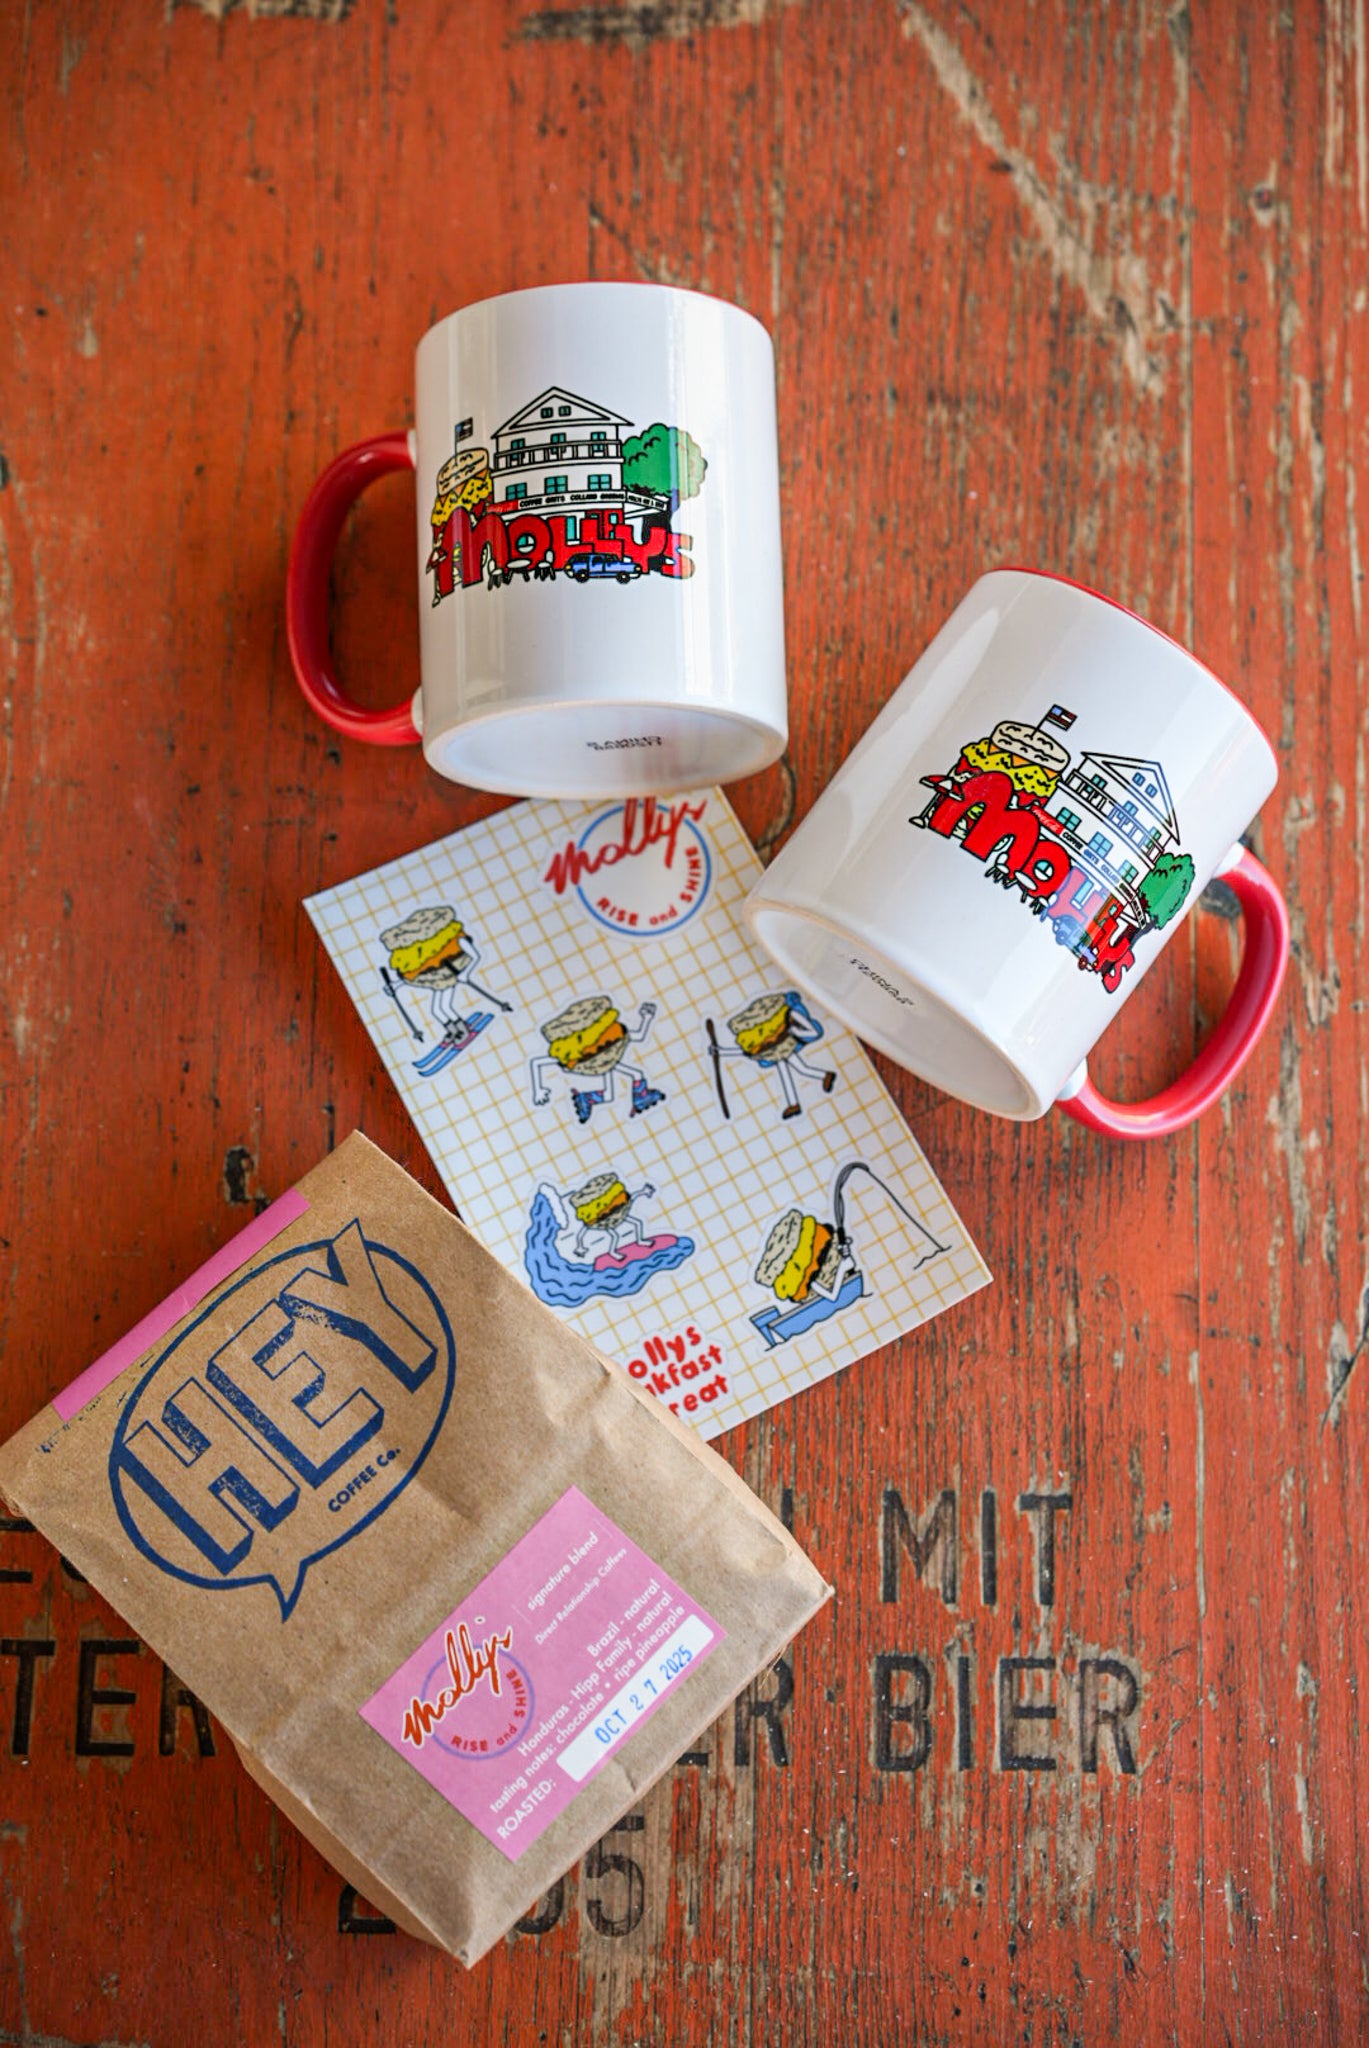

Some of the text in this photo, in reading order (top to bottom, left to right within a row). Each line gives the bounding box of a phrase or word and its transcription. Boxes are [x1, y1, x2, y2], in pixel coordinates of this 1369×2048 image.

[595, 845, 704, 926] RISE and SHINE
[118, 1217, 440, 1577] HEY
[327, 1465, 379, 1514] COFFEE
[527, 1531, 599, 1611] signature blend
[534, 1547, 628, 1645] Direct Relationship Coffees
[882, 1488, 1072, 1607] MIT
[586, 1621, 621, 1658] Brazil
[624, 1577, 662, 1621] natural
[451, 1667, 529, 1753] RISE and SHINE
[489, 1603, 687, 1815] tasting notes: chocolate ripe pineapple
[516, 1705, 571, 1759] Honduras
[569, 1671, 601, 1702] Hipp
[595, 1635, 634, 1673] Family
[635, 1589, 674, 1633] natural
[873, 1652, 1145, 1775] BIER
[496, 1778, 558, 1841] ROASTED:
[593, 1707, 629, 1746] OCT
[657, 1643, 695, 1683] 2025
